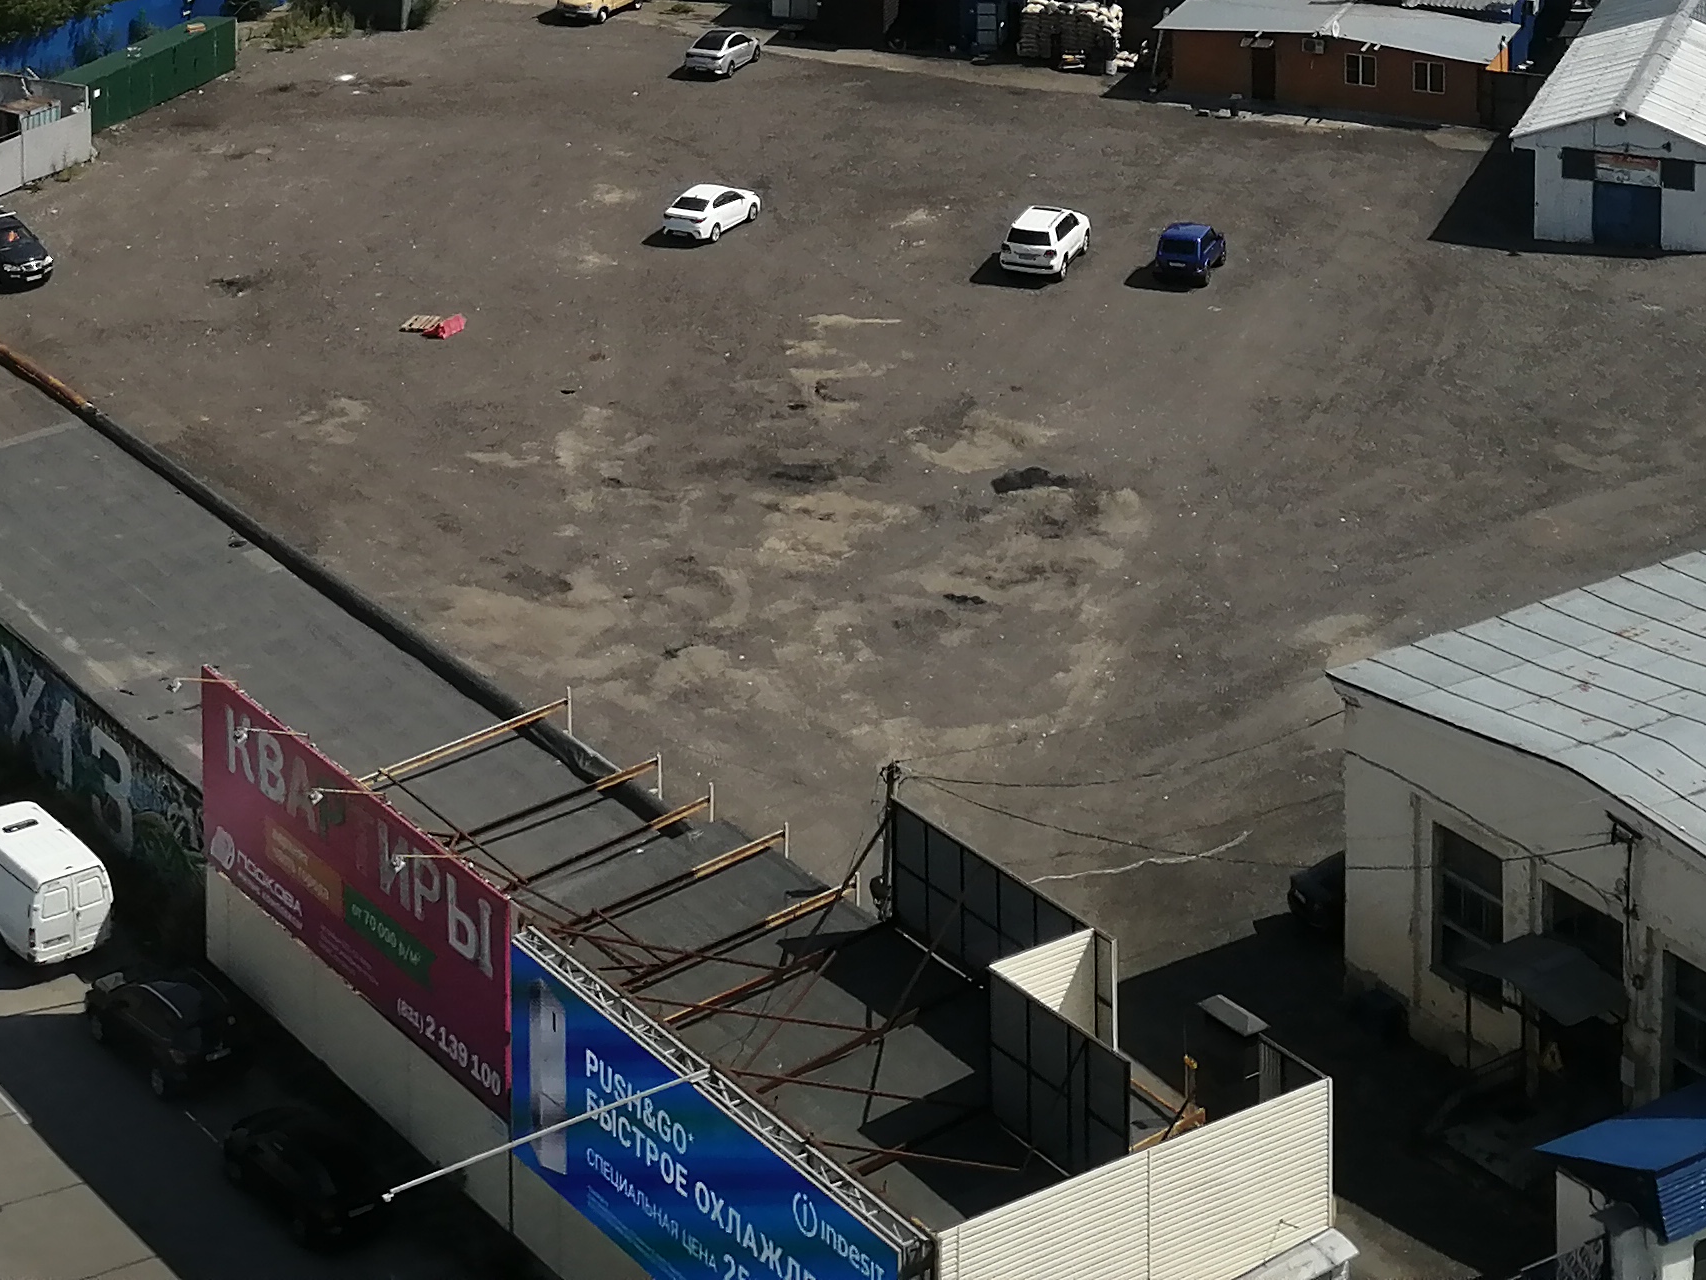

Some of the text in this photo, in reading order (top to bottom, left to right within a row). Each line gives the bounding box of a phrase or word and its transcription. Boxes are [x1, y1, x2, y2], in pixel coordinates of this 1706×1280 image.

[224, 703, 495, 979] КВАРТИРЫ
[424, 1014, 436, 1042] 2
[437, 1025, 468, 1068] 139
[470, 1053, 501, 1096] 100
[586, 1087, 689, 1199] БЫСТРОЕ
[586, 1147, 679, 1240] СПЕЦИАЛЬНАЯ
[682, 1228, 718, 1273] ЦЕНА
